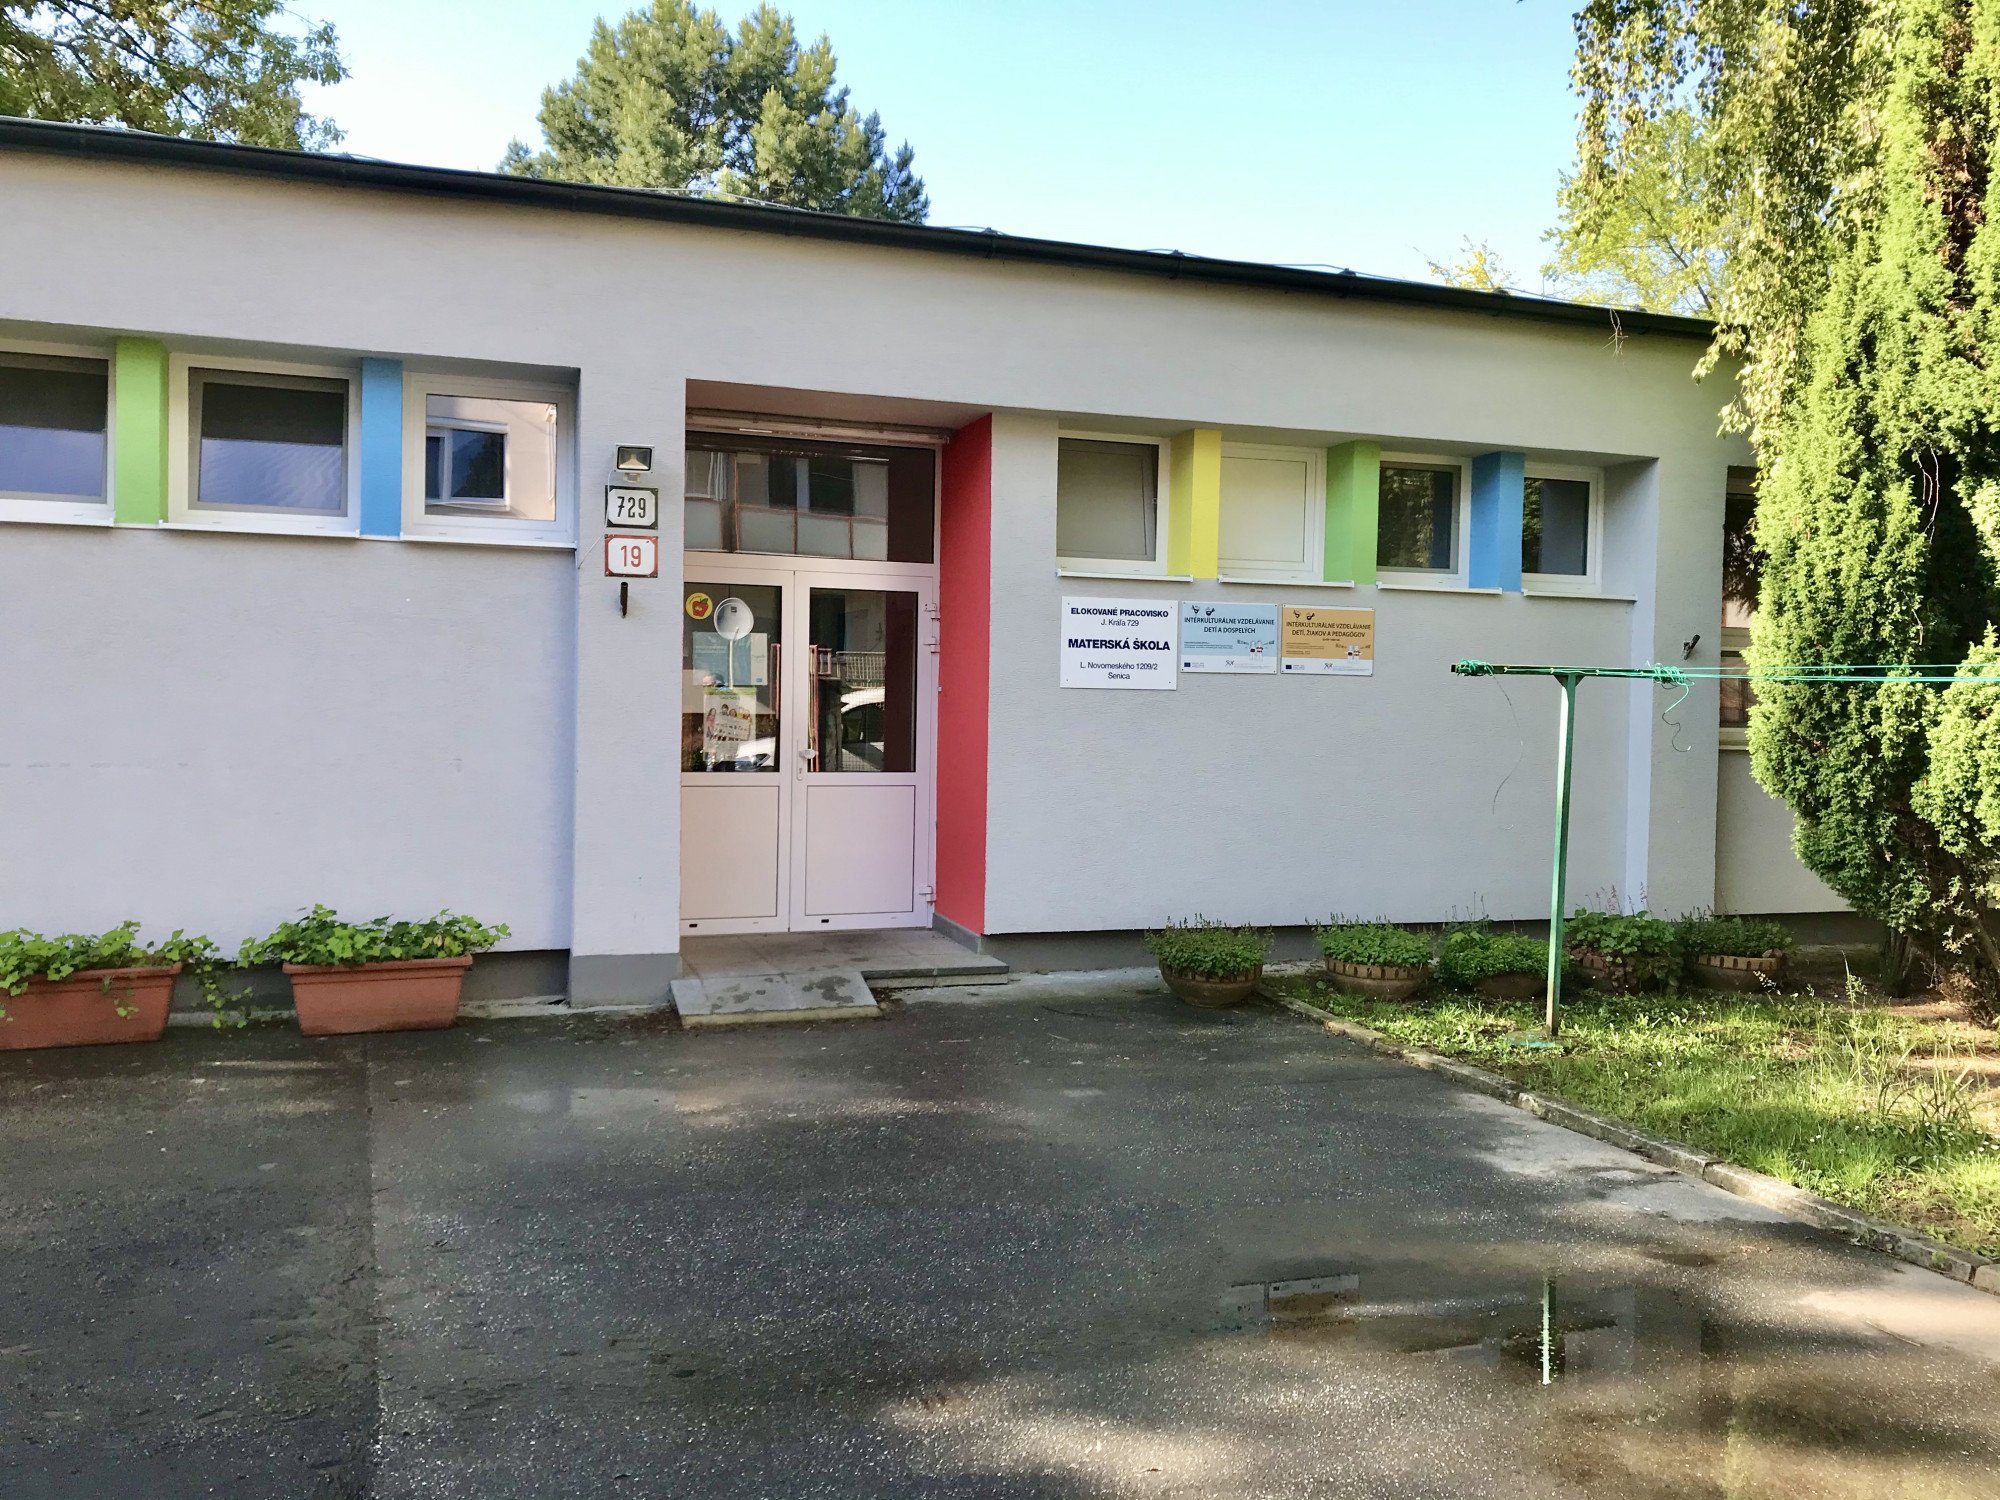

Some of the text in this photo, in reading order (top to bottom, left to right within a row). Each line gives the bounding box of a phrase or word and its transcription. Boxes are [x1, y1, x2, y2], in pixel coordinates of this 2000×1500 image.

[617, 496, 646, 519] 729
[620, 545, 642, 568] 19
[1071, 607, 1168, 618] ELOKOVANÉ PRACOVISKO
[1068, 638, 1130, 650] MATERSKÁ
[1133, 638, 1170, 650] ŠKOLA
